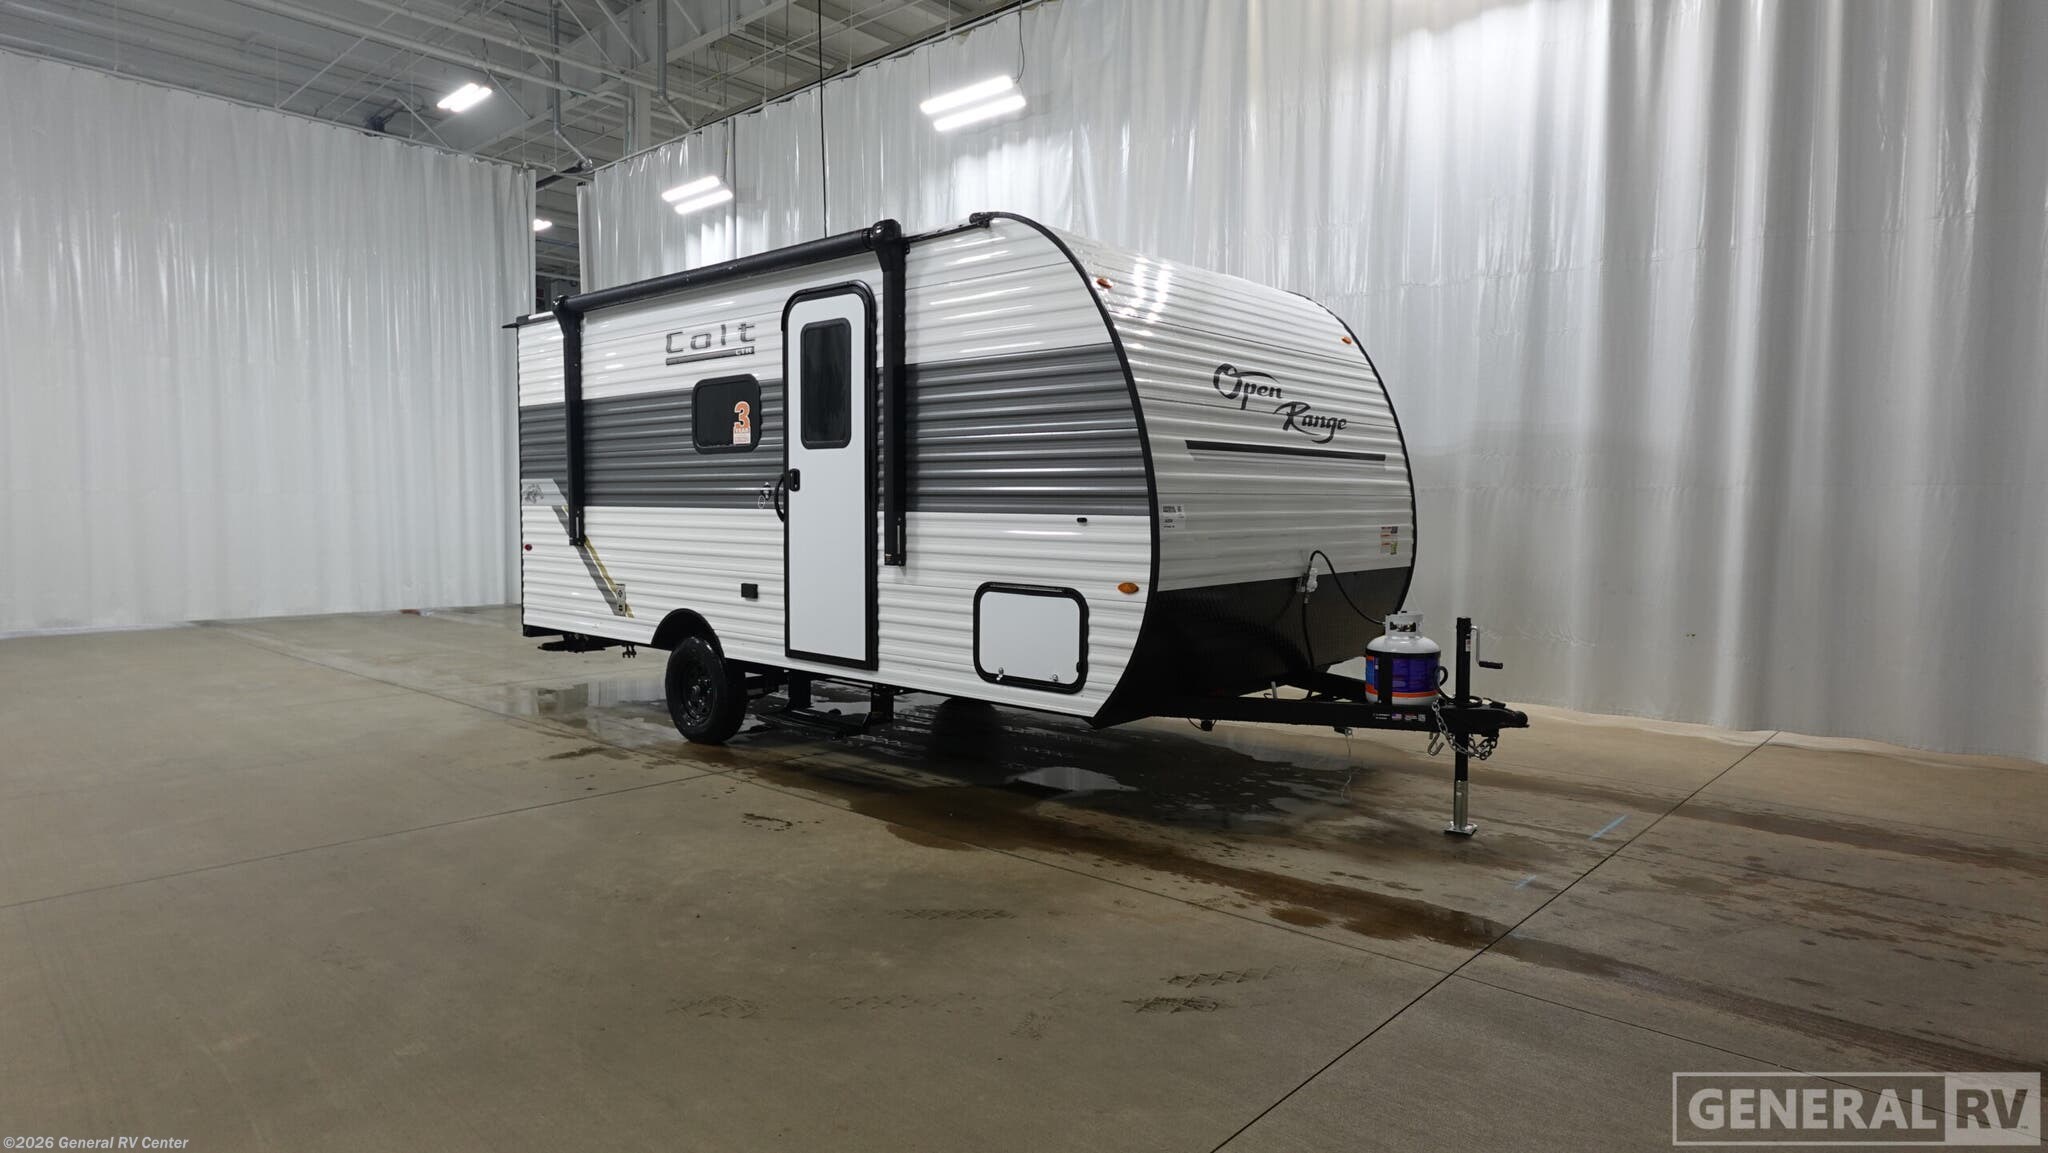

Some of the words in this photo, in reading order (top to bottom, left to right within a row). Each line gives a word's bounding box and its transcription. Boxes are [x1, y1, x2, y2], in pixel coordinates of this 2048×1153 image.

[666, 323, 755, 353] Colt
[1213, 363, 1283, 410] Open
[734, 401, 750, 428] 3
[1273, 401, 1347, 444] Range
